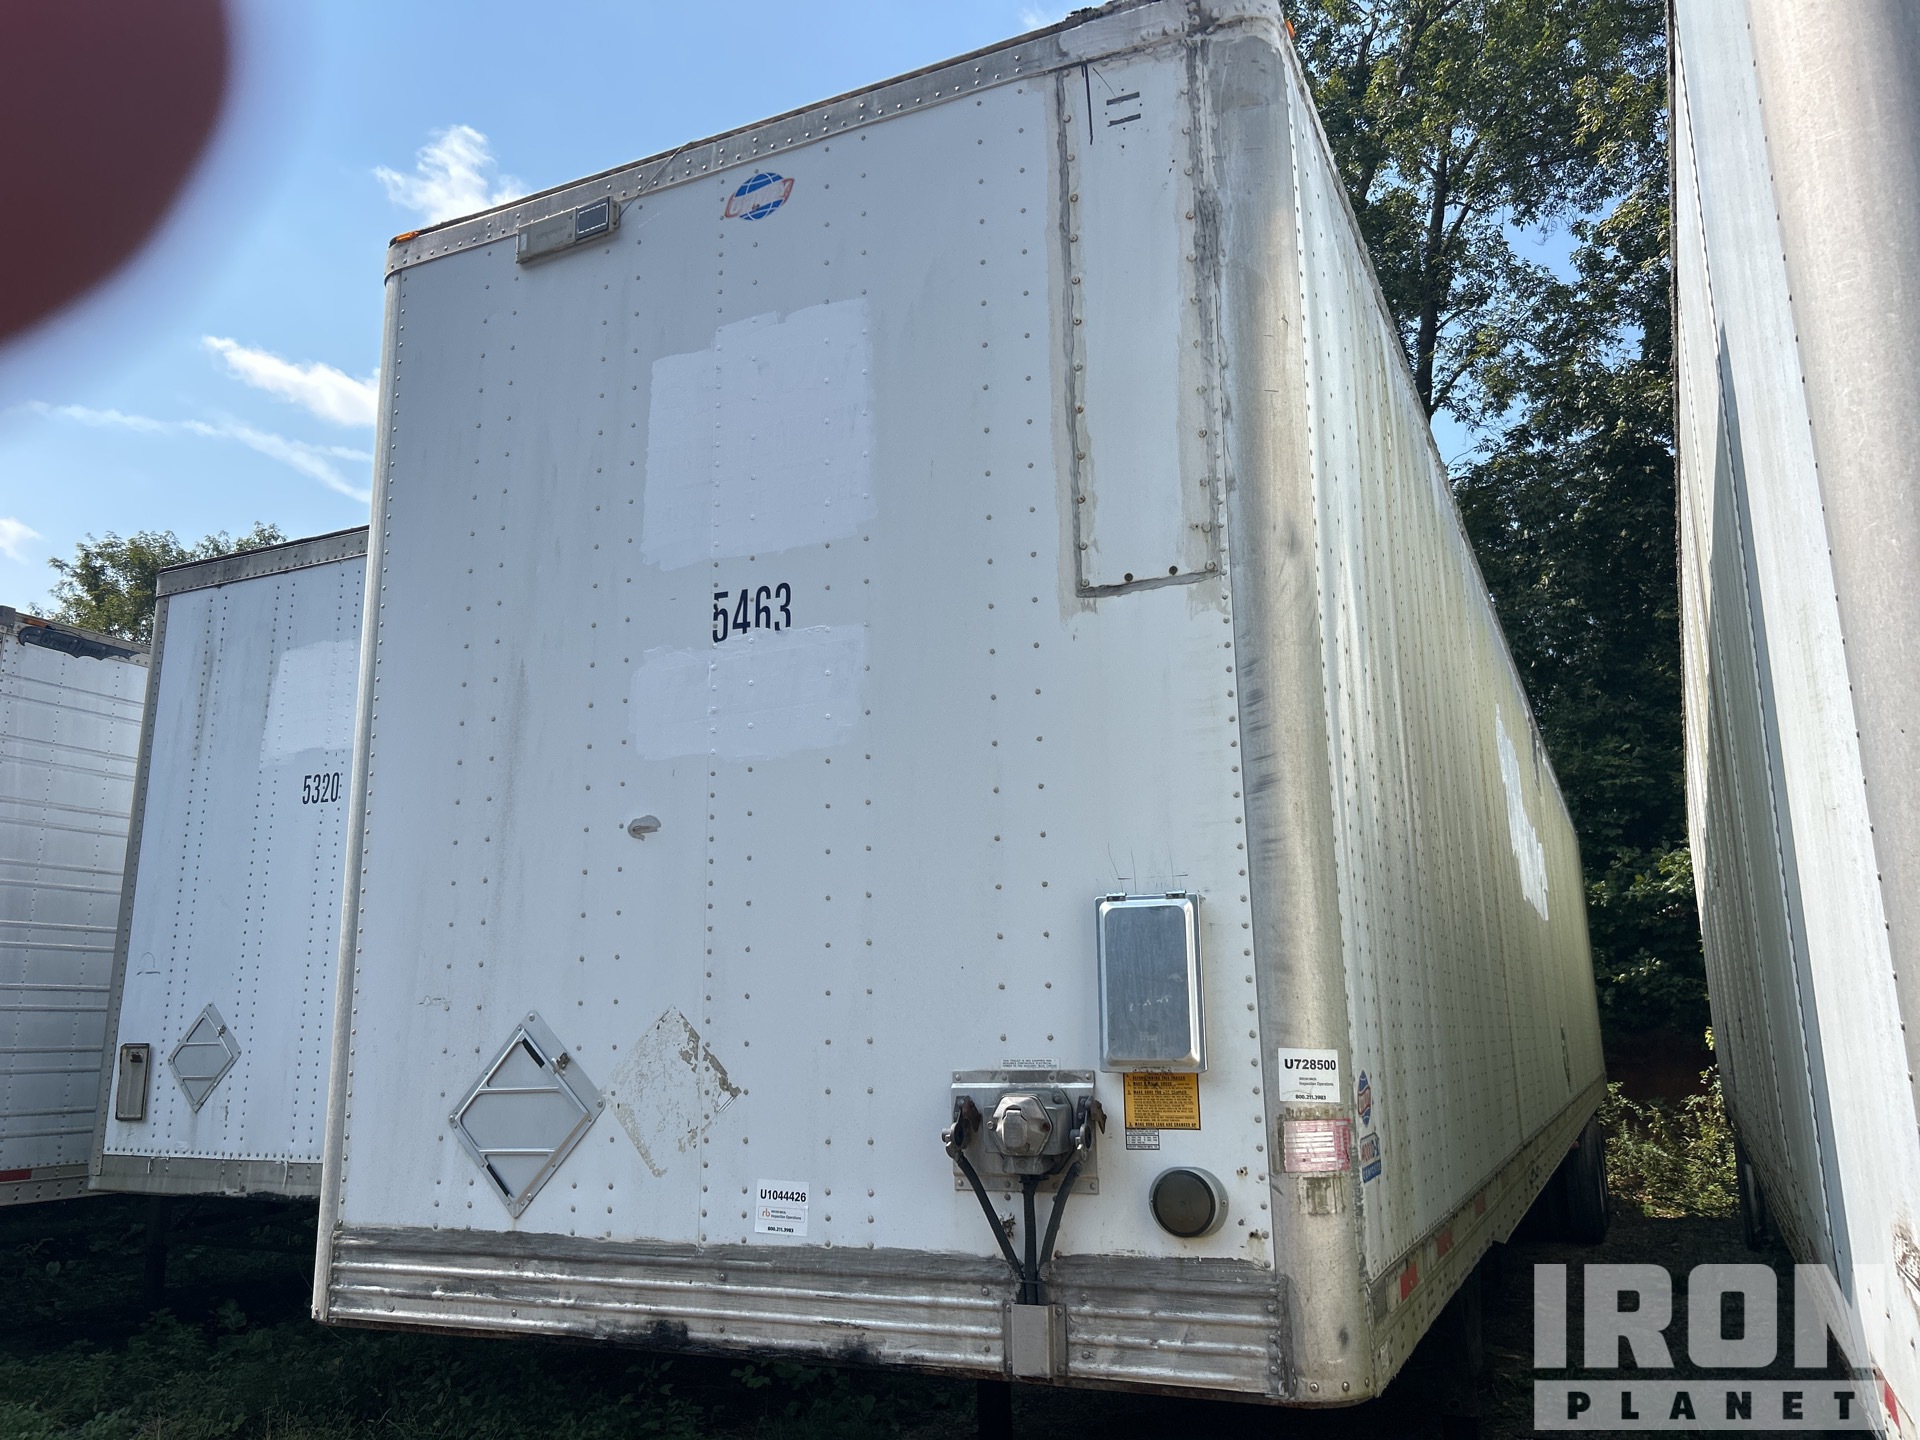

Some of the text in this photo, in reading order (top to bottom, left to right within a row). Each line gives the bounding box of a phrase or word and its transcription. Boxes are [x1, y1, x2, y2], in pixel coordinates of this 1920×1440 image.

[712, 582, 792, 643] 5463
[302, 772, 340, 804] 5320
[1284, 1058, 1336, 1070] U728500
[760, 1188, 806, 1202] U1044426
